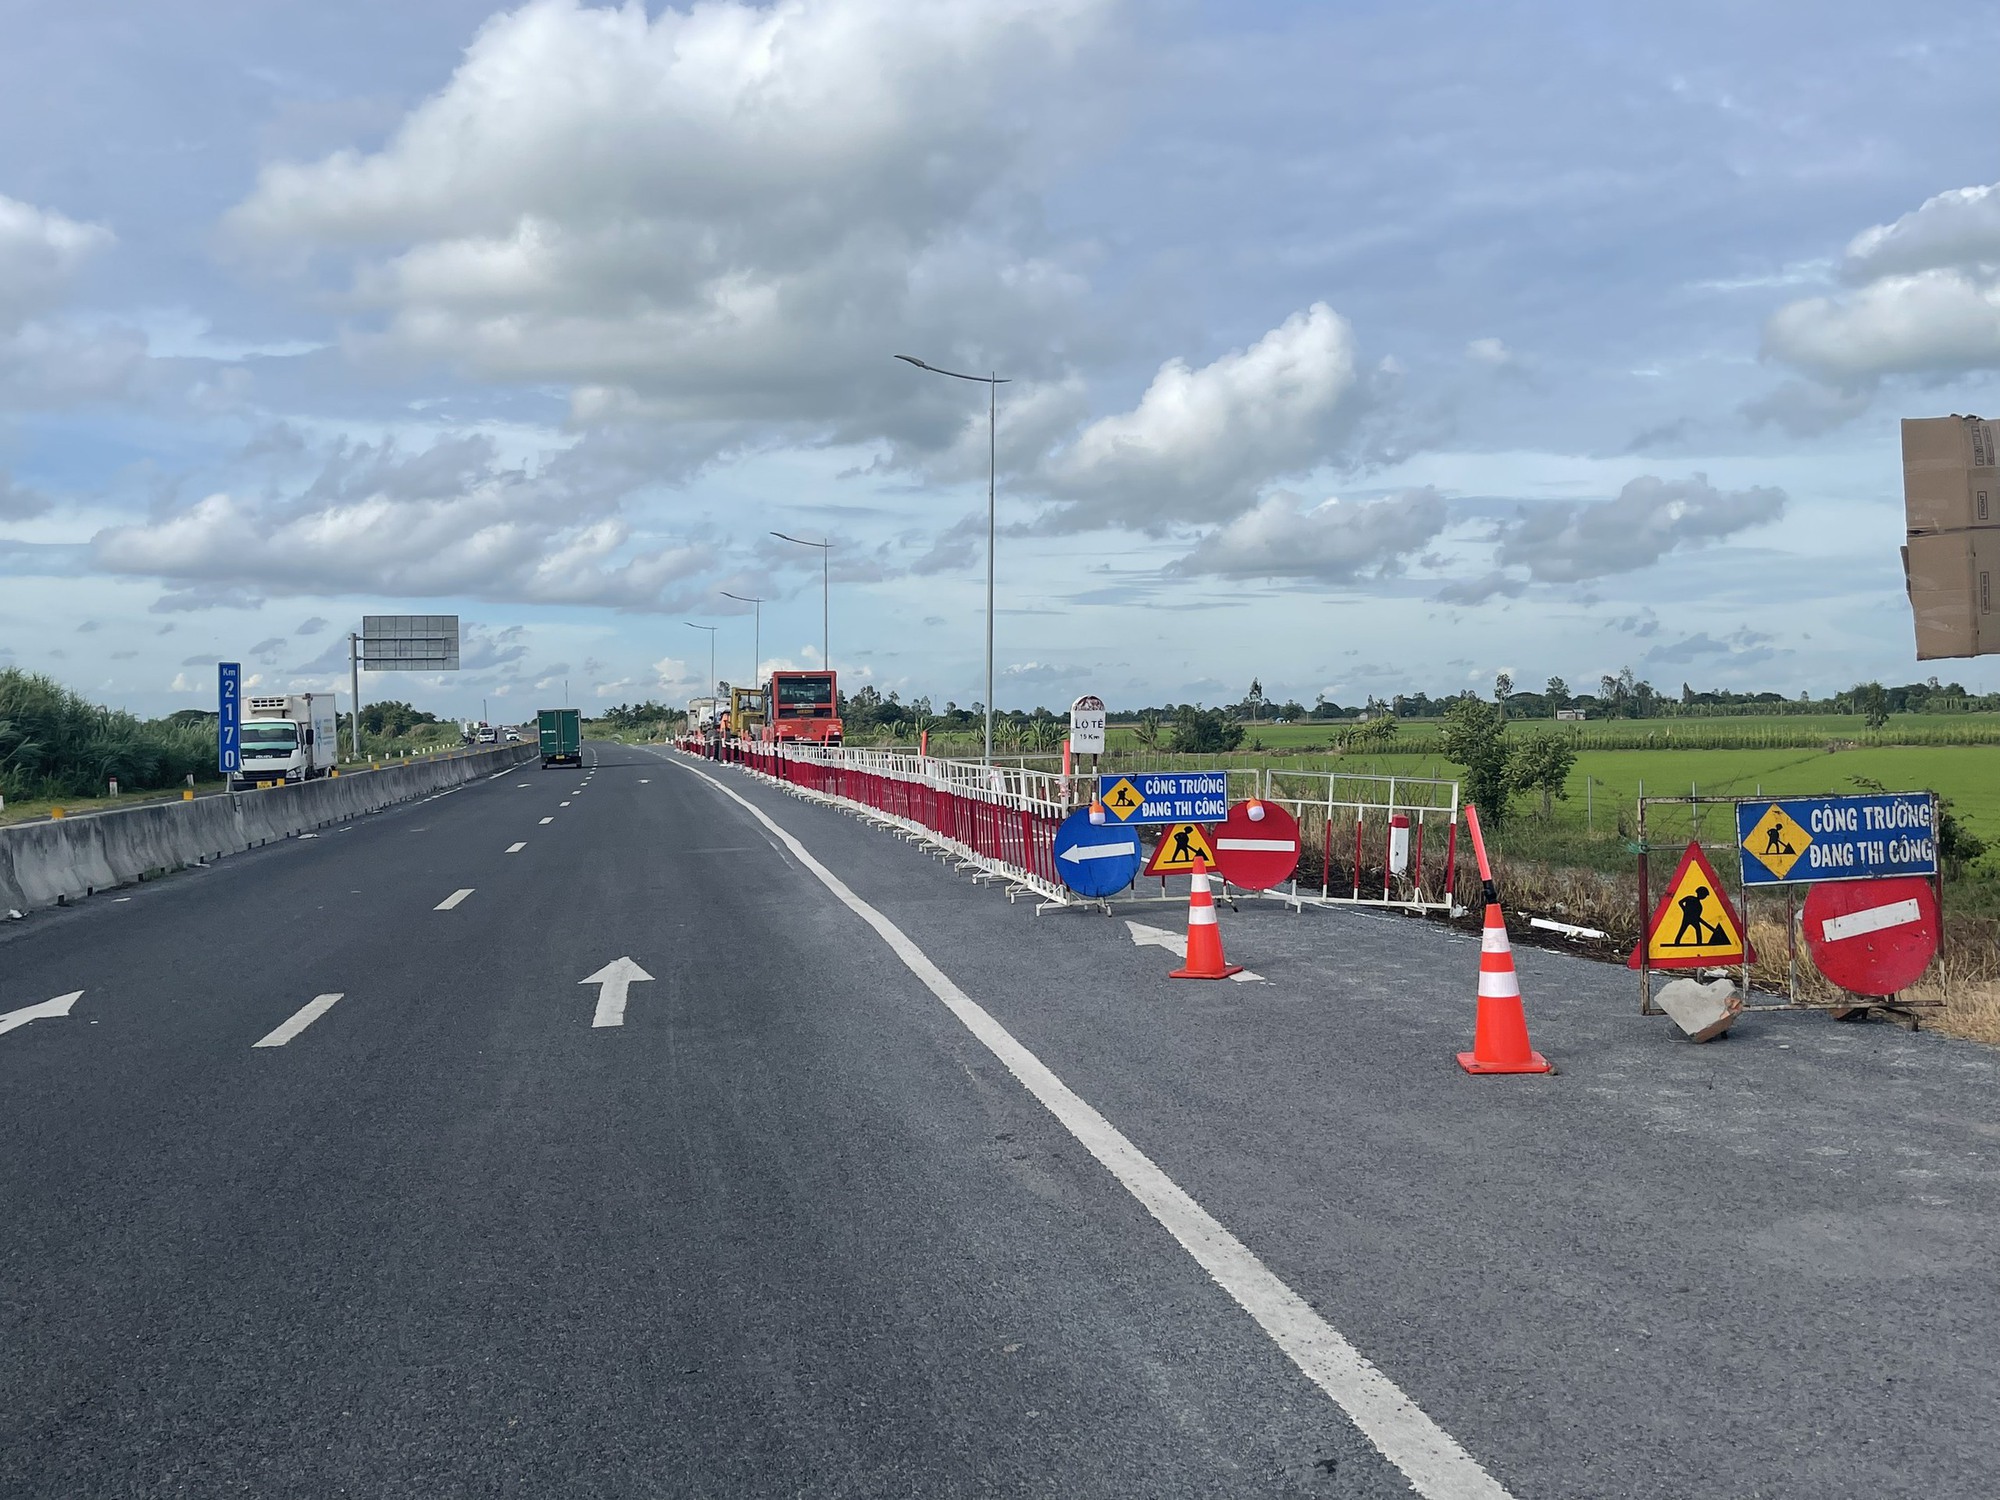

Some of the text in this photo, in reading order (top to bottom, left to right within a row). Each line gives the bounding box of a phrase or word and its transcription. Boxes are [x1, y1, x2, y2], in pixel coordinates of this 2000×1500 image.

[223, 668, 236, 676] Km
[1145, 774, 1223, 795] CÔNG TRƯỜNG
[1142, 797, 1224, 817] ĐANG THI CÔNG
[1811, 797, 1930, 832] CÔNG TRƯỜNG
[1810, 834, 1932, 867] ĐANG THI CÔNG
